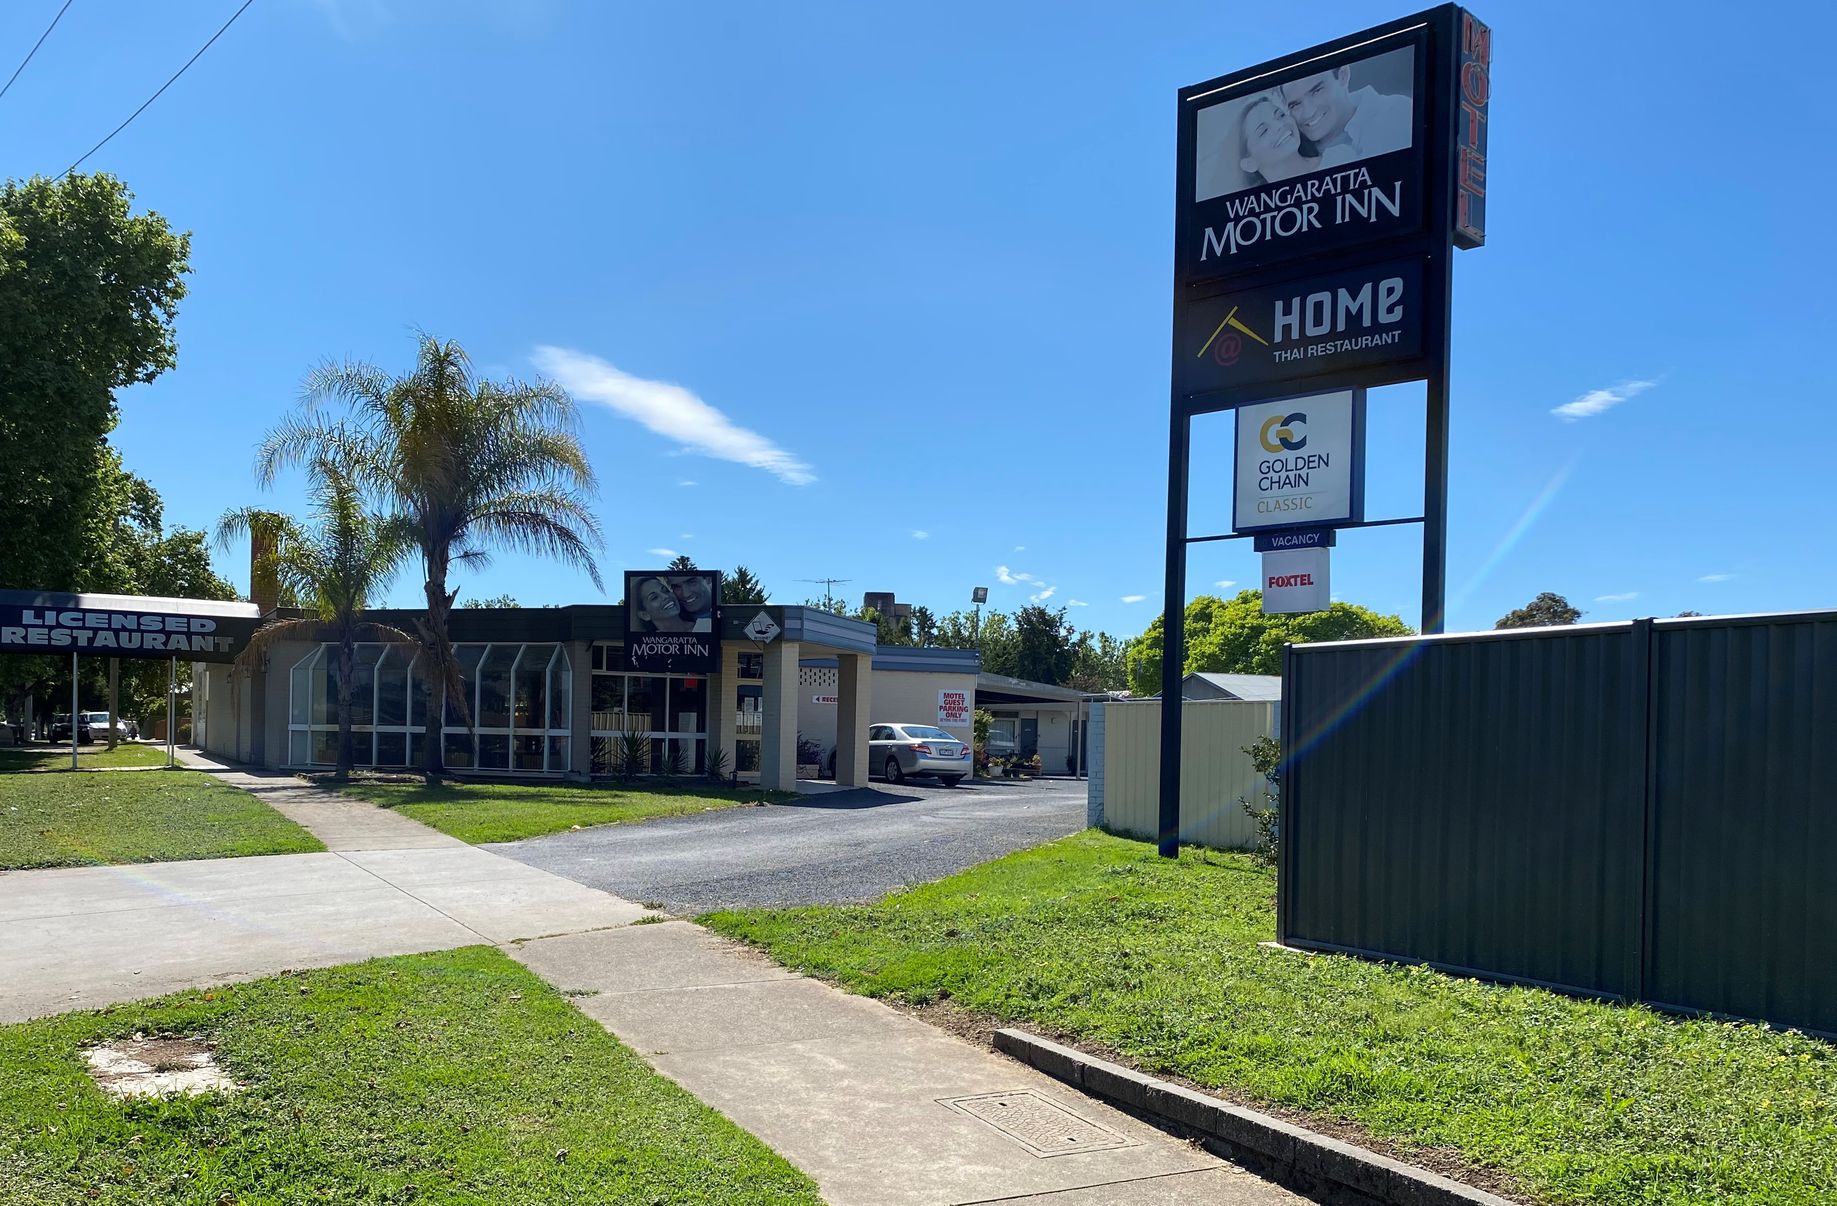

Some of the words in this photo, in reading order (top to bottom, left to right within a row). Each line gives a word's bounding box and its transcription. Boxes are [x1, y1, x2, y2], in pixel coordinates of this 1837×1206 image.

[1460, 13, 1489, 235] MOTEL
[1225, 166, 1372, 219] WANGARATTA
[1200, 202, 1322, 262] MOTOR
[1335, 181, 1402, 225] INN
[1273, 347, 1304, 363] THAI
[1307, 331, 1401, 358] RESTAURANT
[1259, 453, 1330, 475] GOLDEN
[1258, 473, 1309, 491] CHAIN
[1257, 496, 1313, 513] CLASSIC
[1271, 533, 1320, 547] VACANCY
[1268, 573, 1314, 588] FOXTEL
[22, 610, 217, 633] LICENSED
[1, 626, 235, 652] RESTAURANT
[642, 636, 698, 644] WANGARATTA
[632, 643, 680, 656] MOTOR
[684, 644, 709, 657] INN
[945, 711, 962, 719] ONLY
